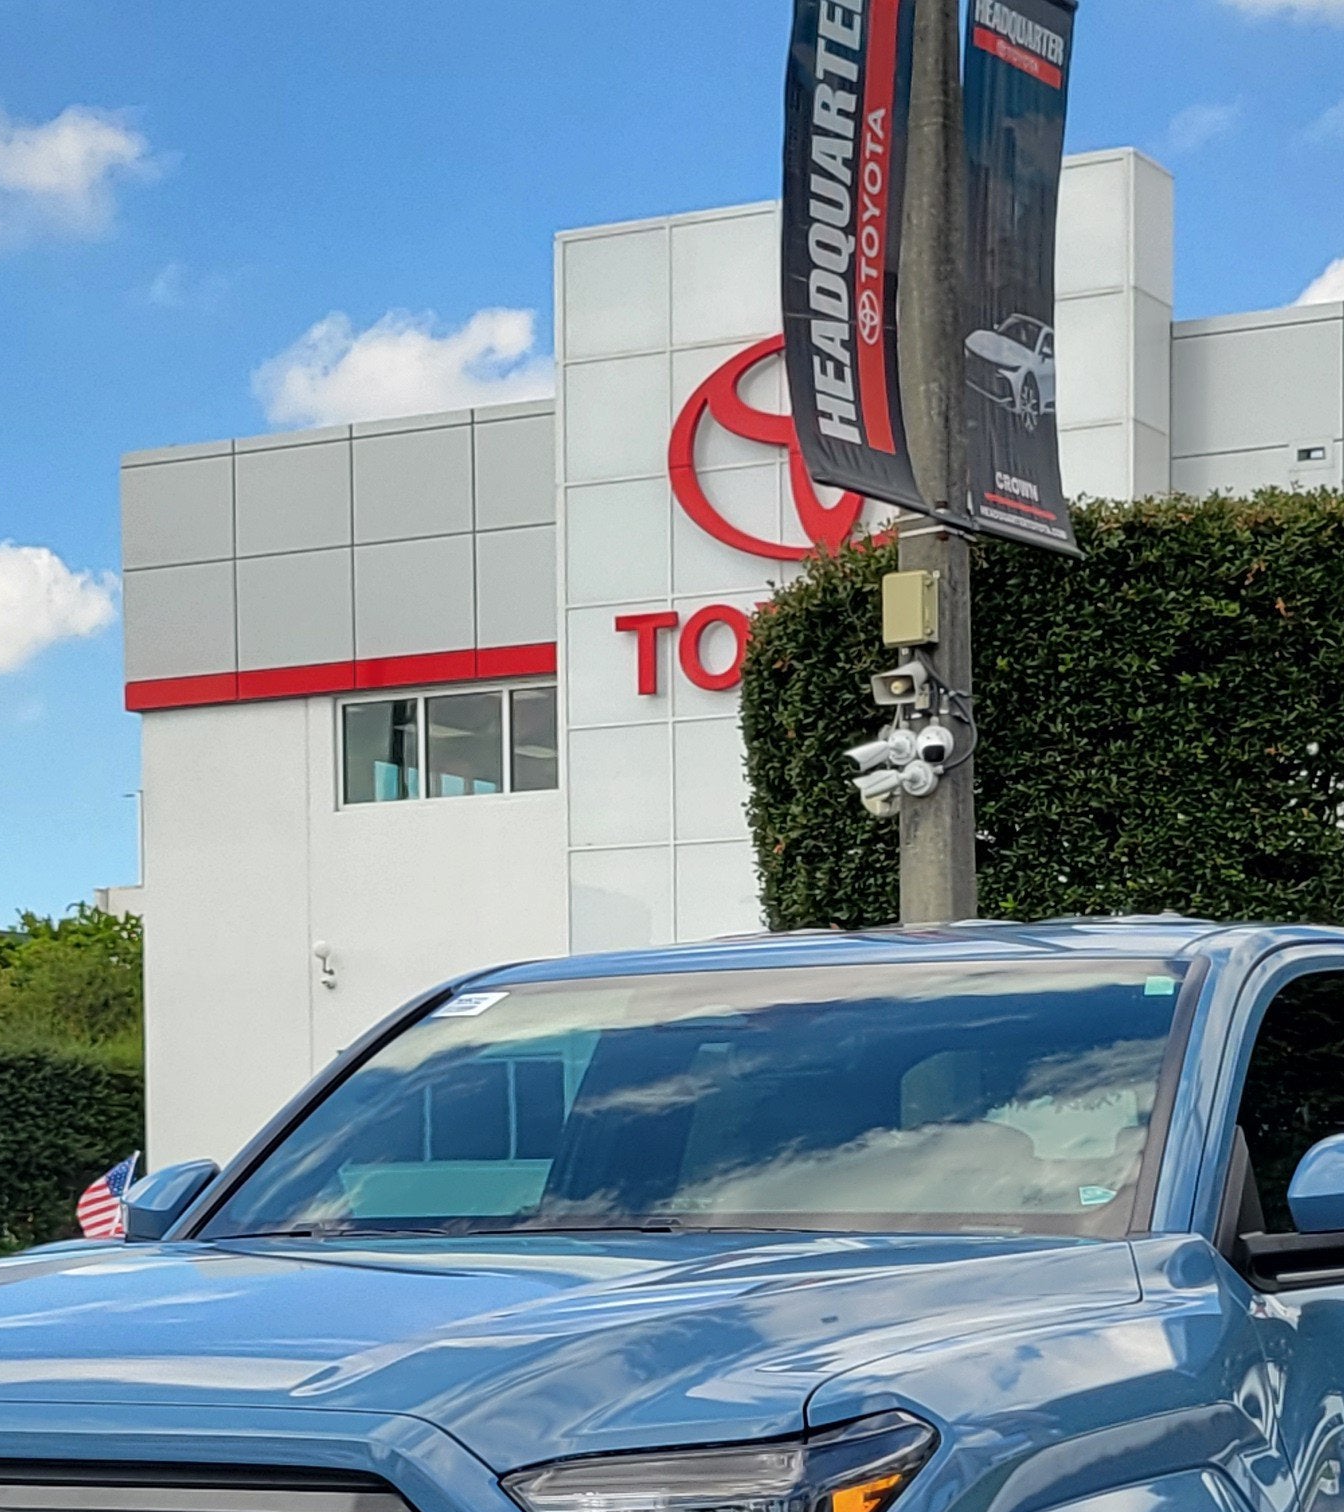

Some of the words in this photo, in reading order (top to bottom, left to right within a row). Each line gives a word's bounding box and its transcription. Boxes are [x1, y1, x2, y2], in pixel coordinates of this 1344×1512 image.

[808, 0, 862, 445] HEADQUARTE
[861, 107, 887, 283] TOYOTA
[995, 471, 1039, 502] CROWN
[615, 602, 766, 696] TO
